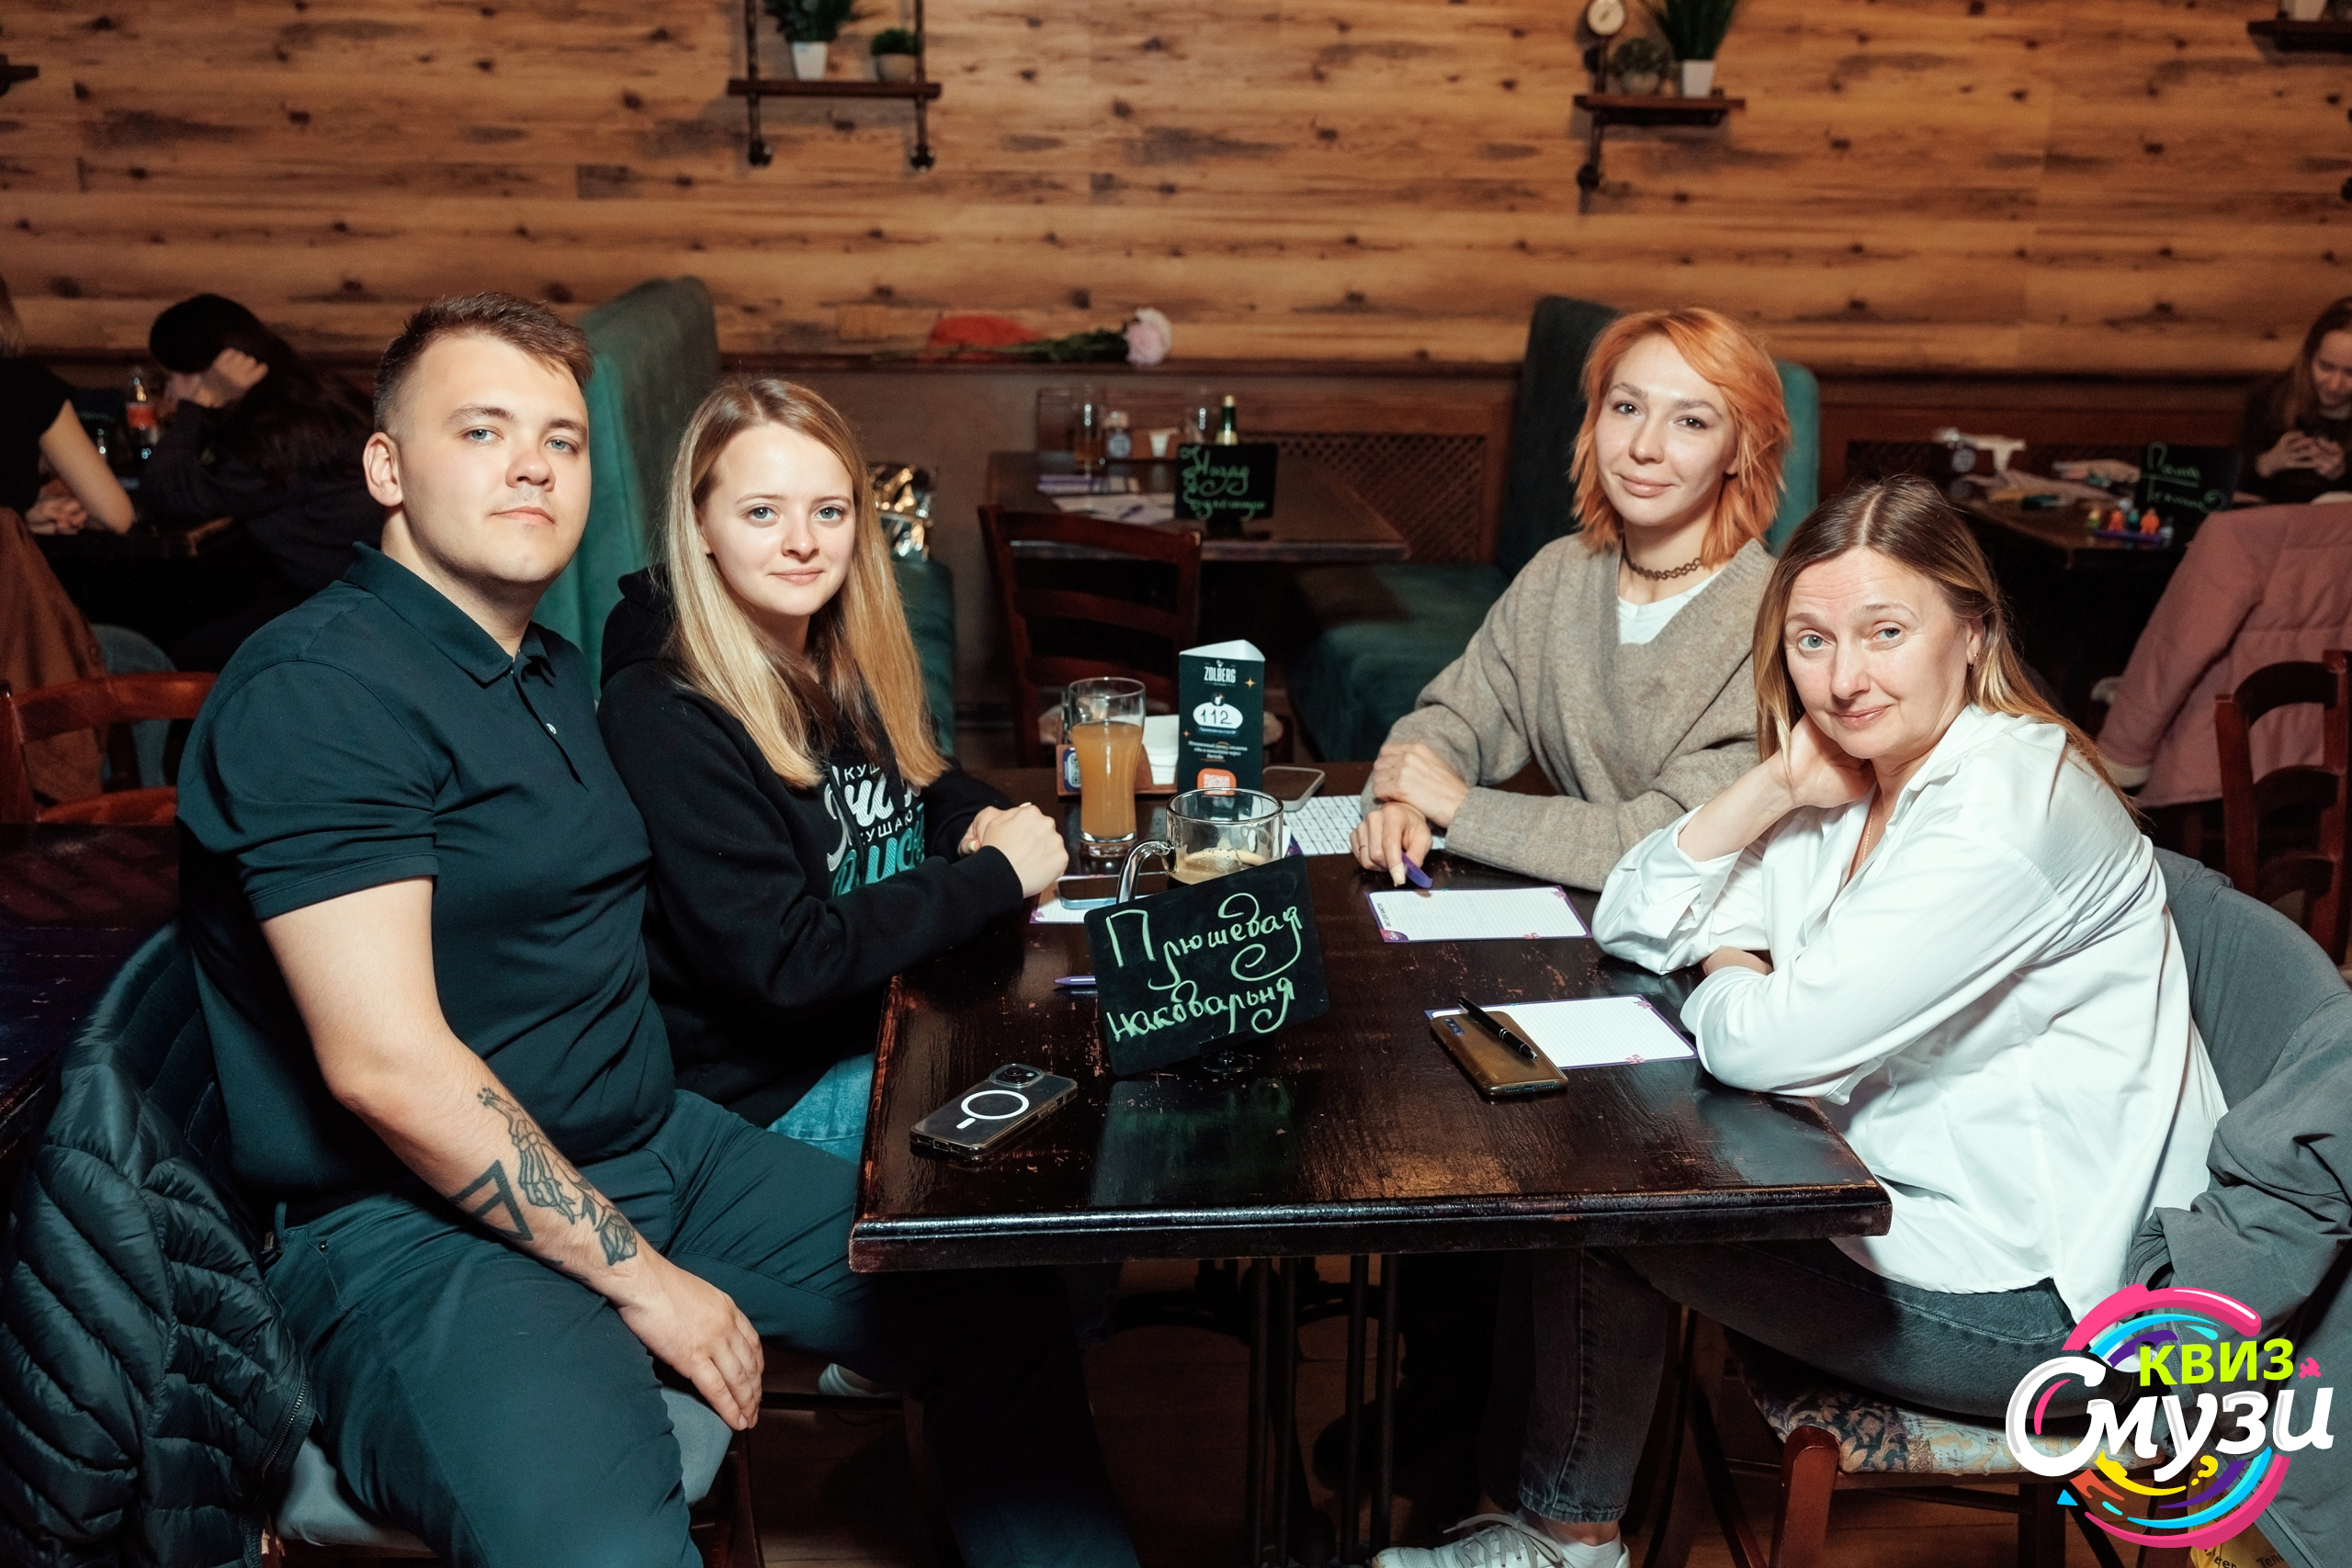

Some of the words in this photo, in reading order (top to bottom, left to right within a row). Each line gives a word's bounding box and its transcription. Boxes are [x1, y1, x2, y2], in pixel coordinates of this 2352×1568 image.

[1204, 666, 1237, 683] ZOLBERG
[1200, 709, 1232, 725] 112
[860, 809, 913, 845] УШАЮ
[1106, 893, 1302, 990] Плюшевая
[1106, 979, 1295, 1042] наковальня
